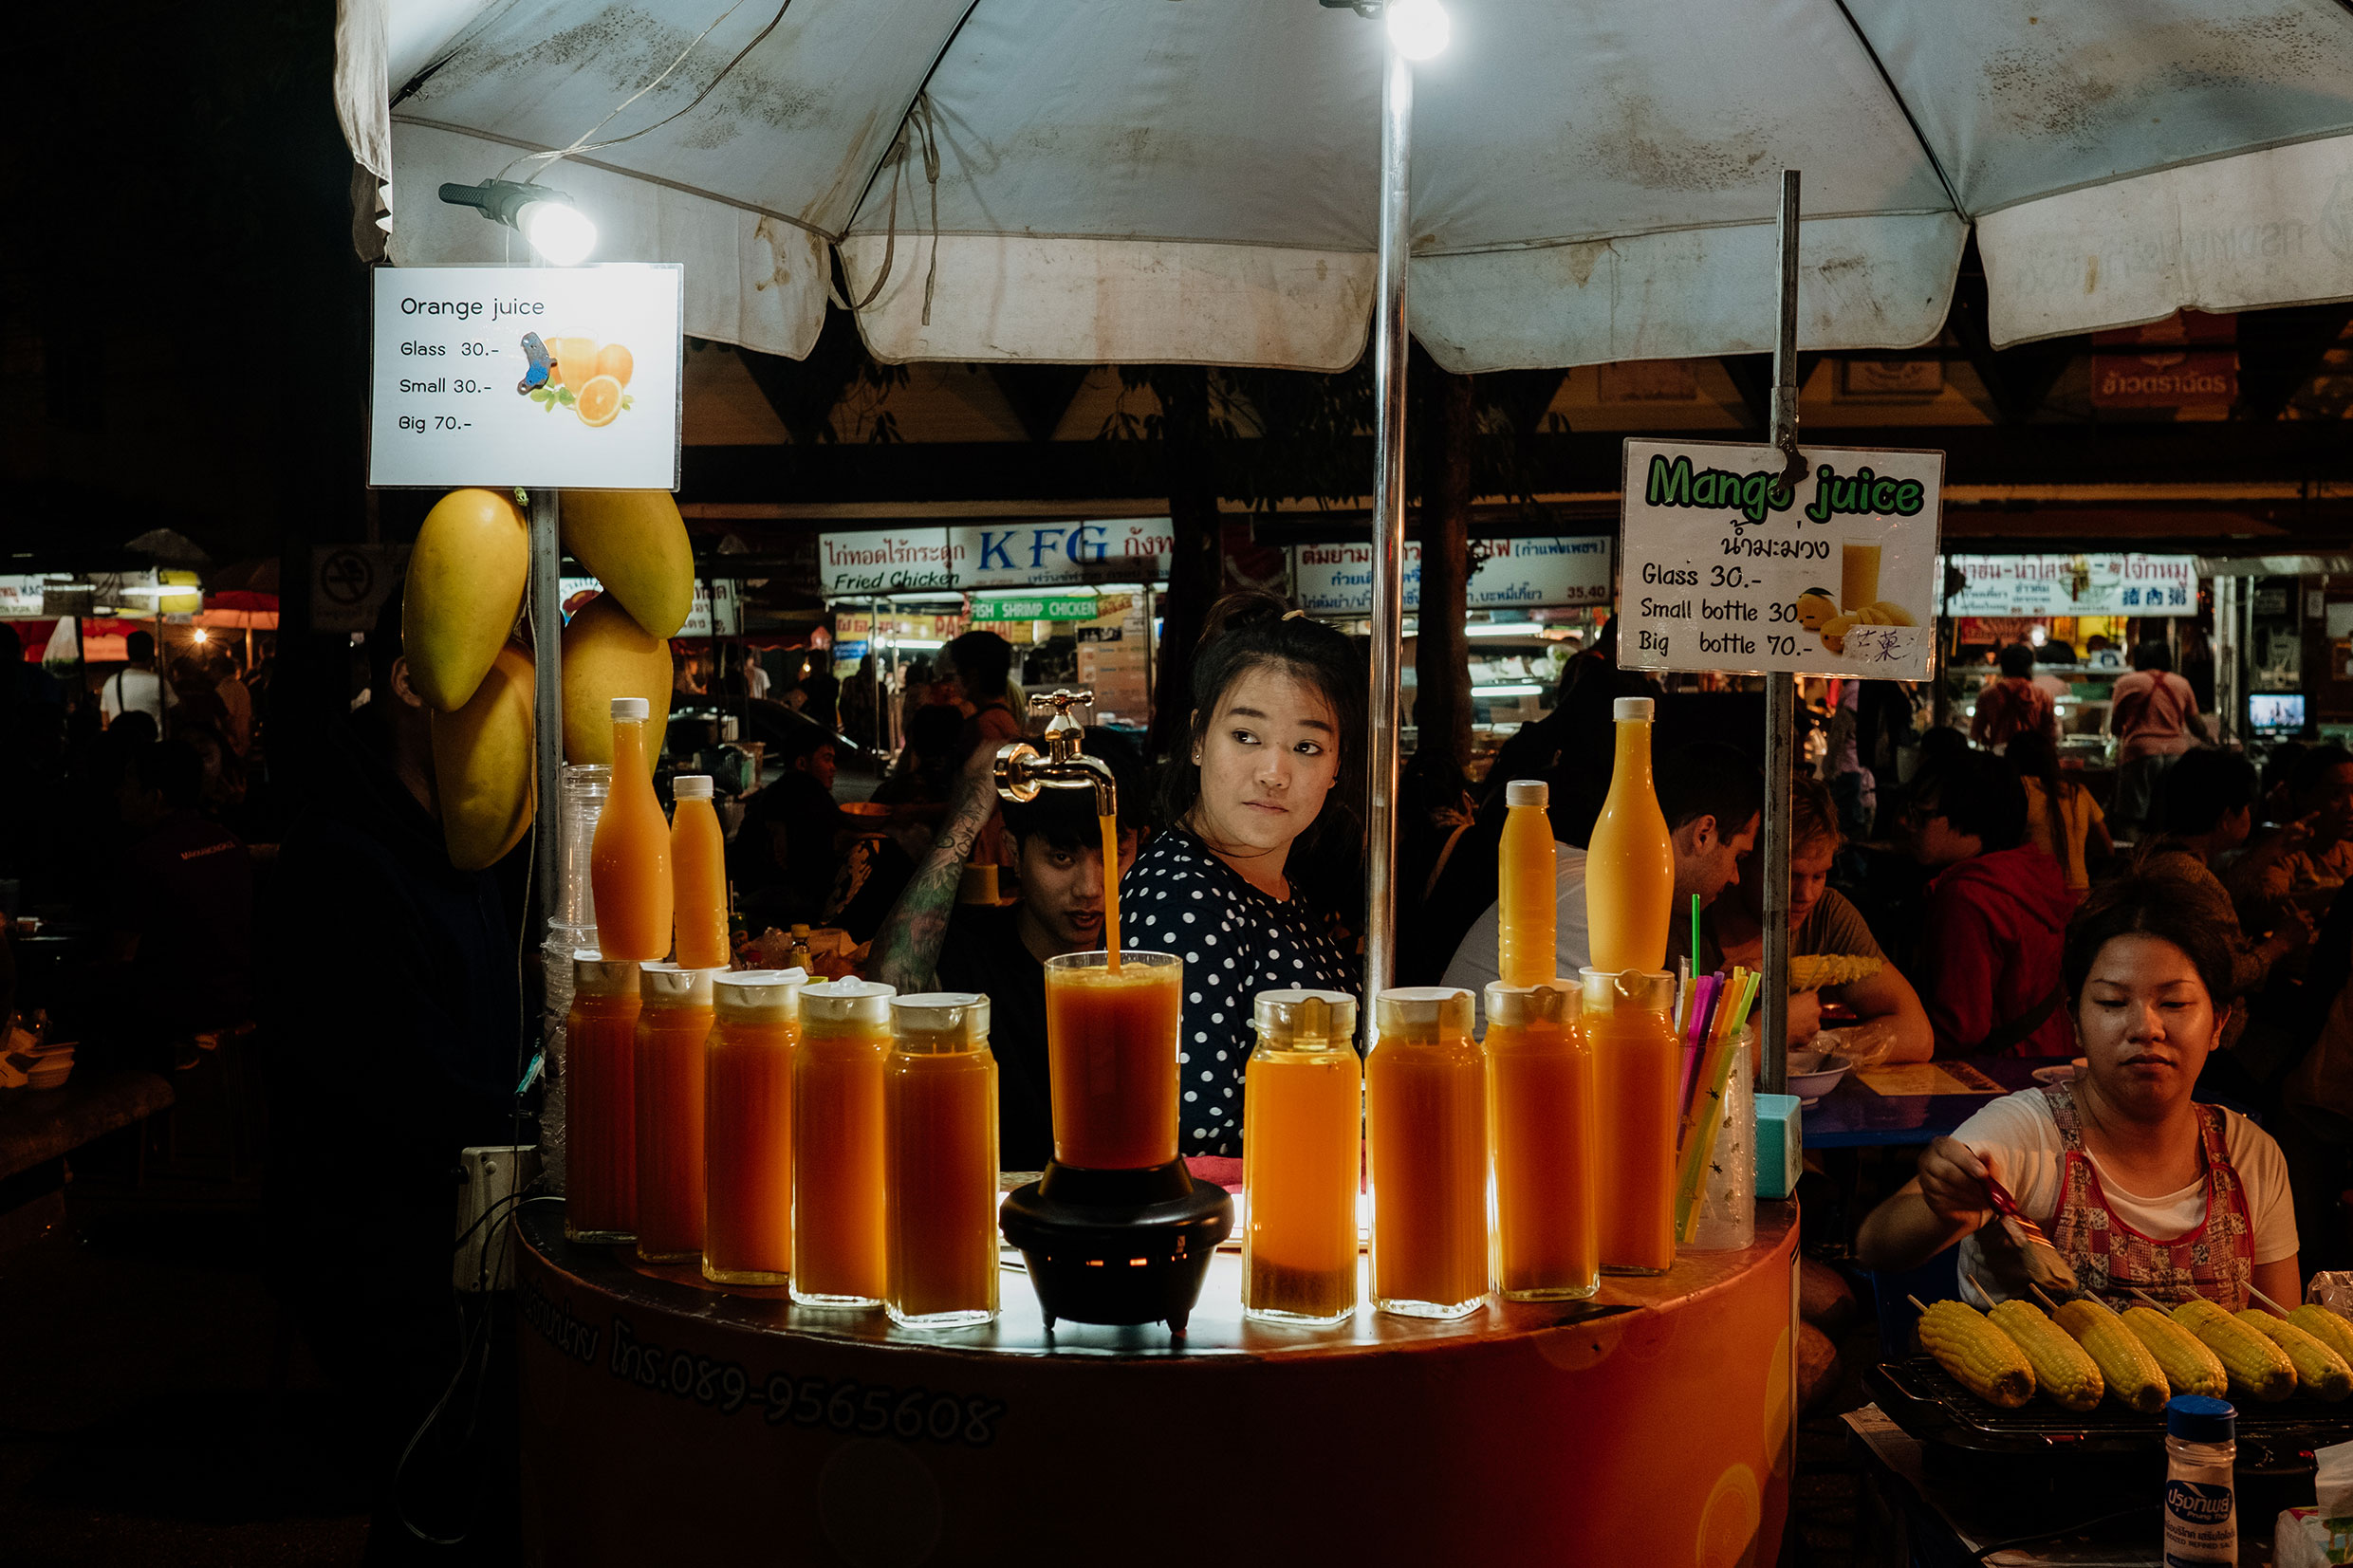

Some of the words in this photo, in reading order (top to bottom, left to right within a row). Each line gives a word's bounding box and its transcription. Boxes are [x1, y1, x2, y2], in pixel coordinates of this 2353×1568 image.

[400, 297, 484, 321] Orange
[491, 297, 546, 322] juice
[399, 341, 447, 357] Glass
[460, 342, 500, 357] 30.-
[398, 378, 447, 394] Small
[453, 378, 492, 394] 30.-
[398, 415, 426, 434] Big
[434, 415, 472, 431] 70.-
[1645, 453, 1796, 525] Mango
[1805, 463, 1925, 525] juice
[1720, 519, 1830, 560] น้ำมะม่วง
[824, 537, 966, 570] ไก่ทอดไร้กระดูก
[834, 571, 887, 590] Fried
[889, 570, 960, 589] Chicken
[1641, 563, 1699, 586] Glass
[1710, 564, 1762, 589] 30.-
[971, 602, 995, 618] FISH
[1002, 601, 1045, 618] SHRIMP
[1047, 600, 1098, 617] CHICKEN
[1640, 598, 1693, 619] Small
[1701, 598, 1758, 621] bottle
[1638, 630, 1670, 656] Big
[1699, 631, 1756, 655] bottle
[1767, 635, 1813, 656] 70.-
[610, 1315, 1006, 1447] โทร.089-9565608
